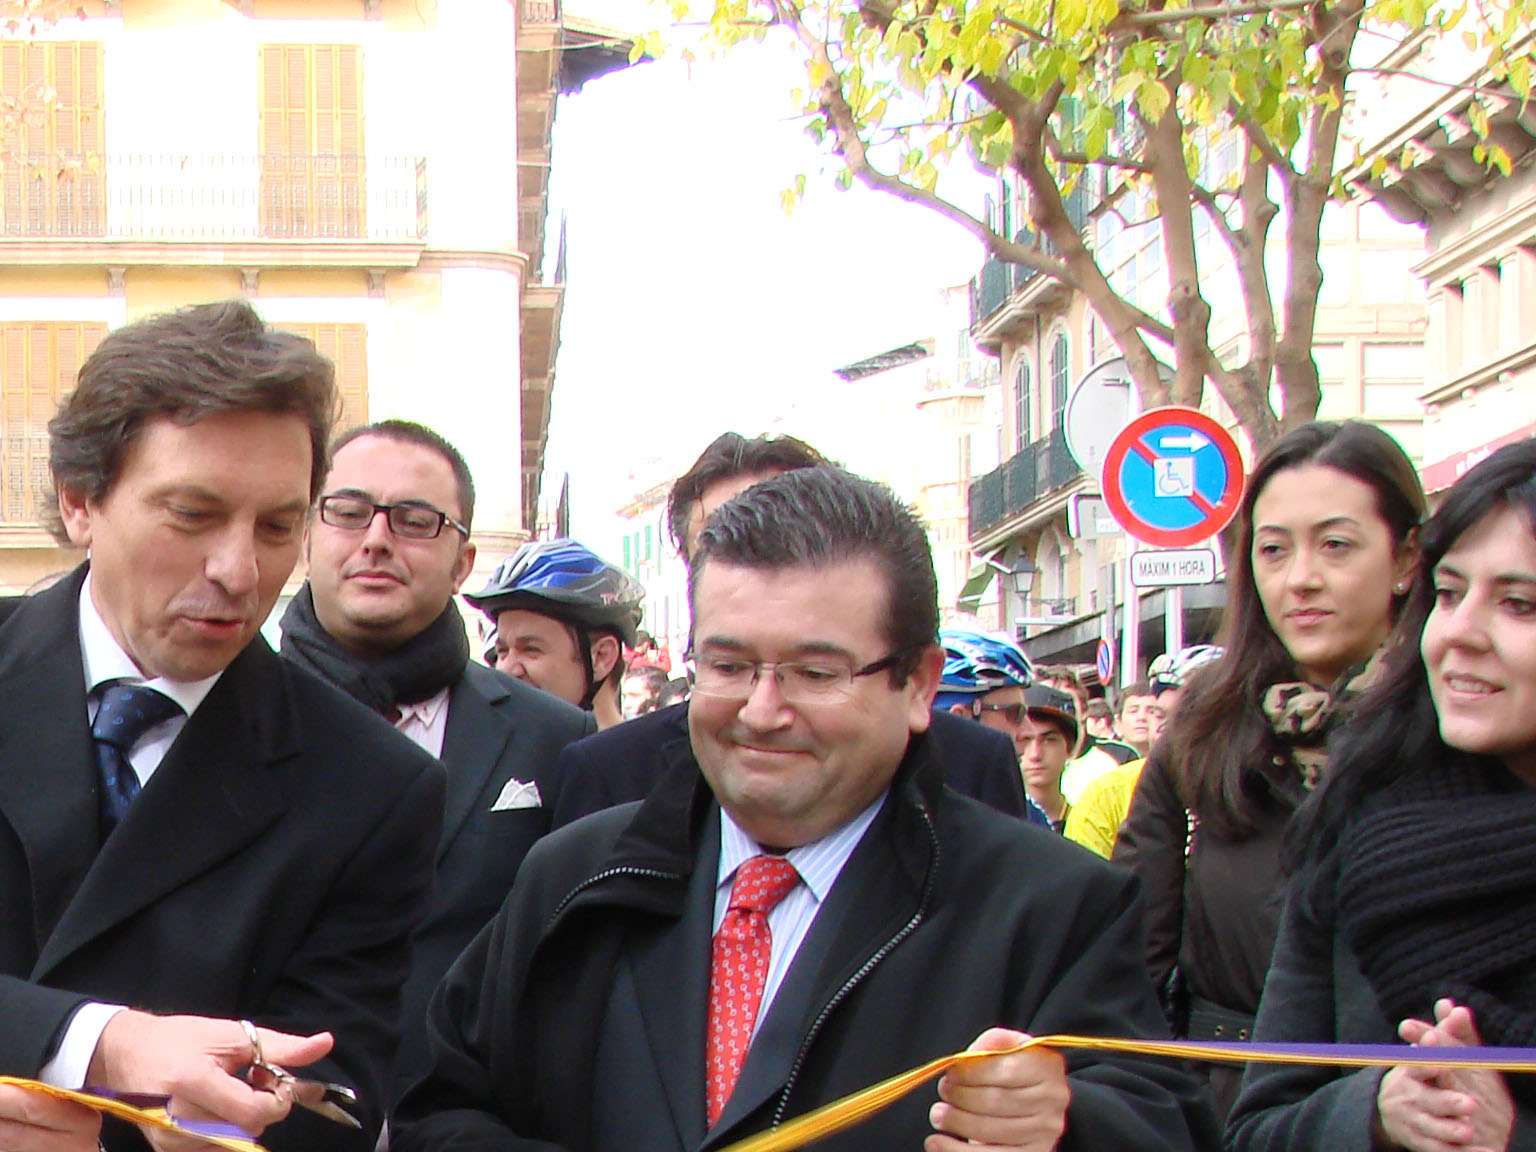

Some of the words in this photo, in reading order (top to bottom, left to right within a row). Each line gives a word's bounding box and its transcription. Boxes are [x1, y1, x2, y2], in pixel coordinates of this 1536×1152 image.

[1139, 558, 1170, 577] MÀXIM
[1172, 562, 1177, 576] 1
[1179, 560, 1206, 576] HORA
